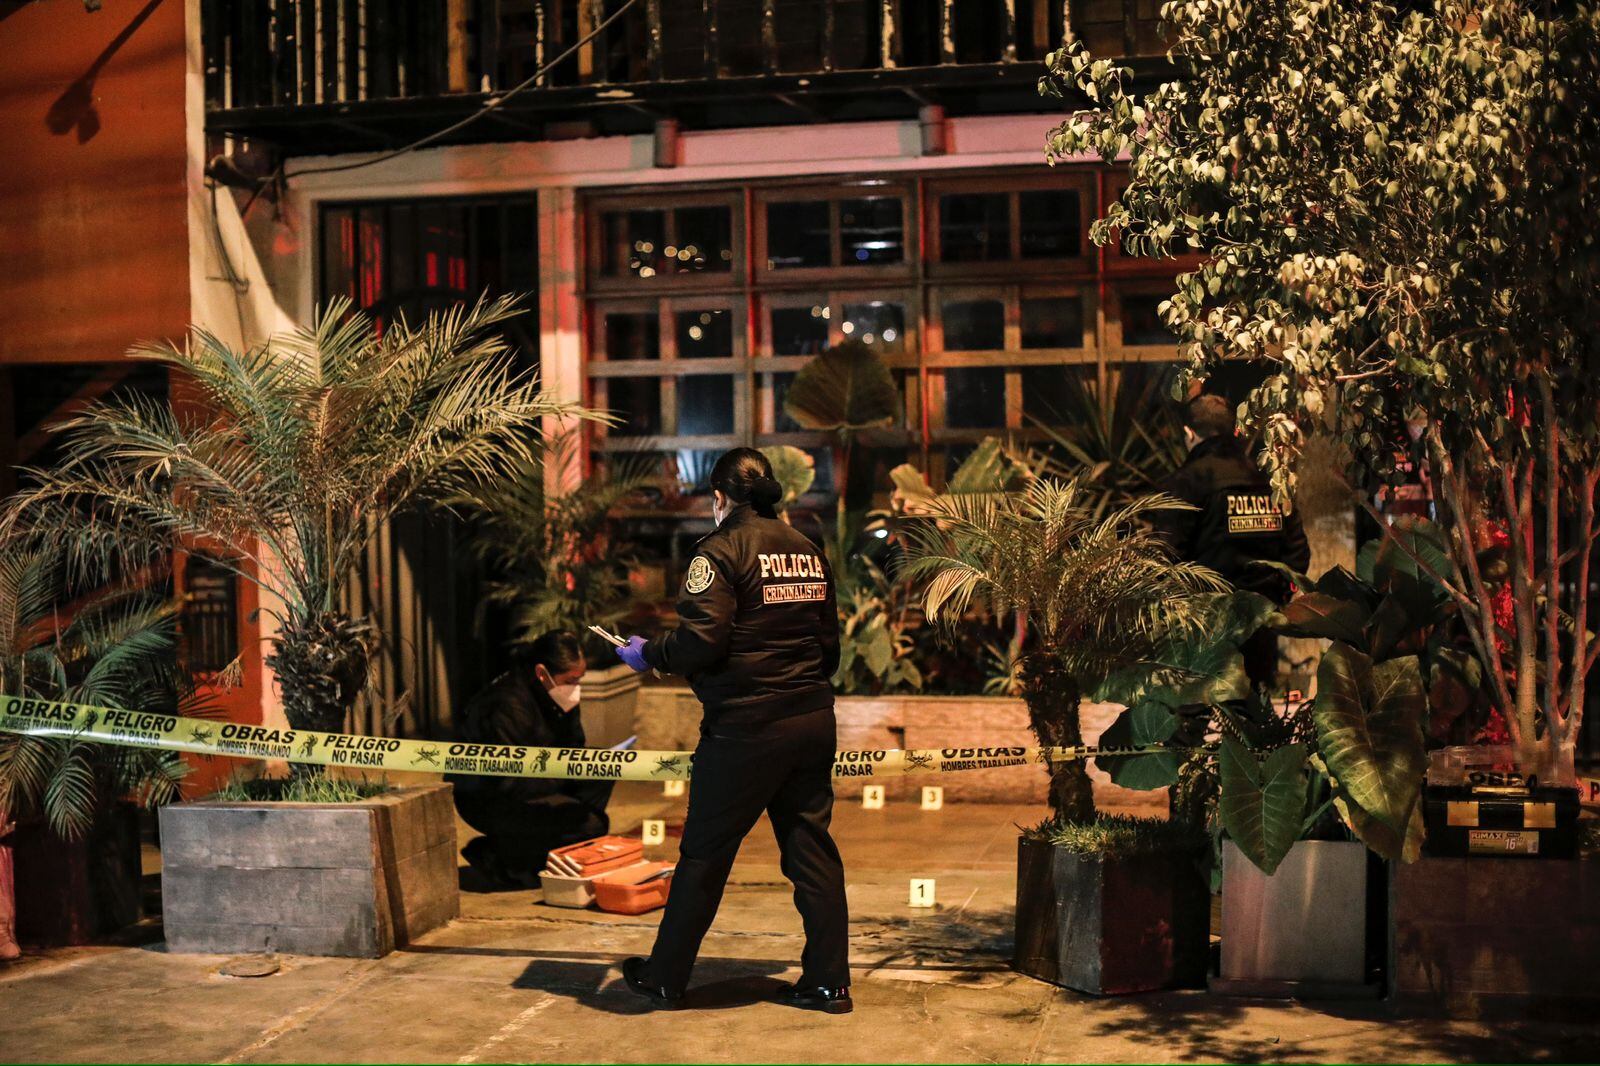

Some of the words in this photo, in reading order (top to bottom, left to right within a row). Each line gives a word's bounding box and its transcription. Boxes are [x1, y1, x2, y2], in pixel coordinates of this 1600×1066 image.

[758, 554, 824, 579] POLICIA
[6, 699, 77, 721] OBRAS
[103, 710, 177, 733] PELIGRO
[221, 724, 296, 744] OBRAS
[323, 735, 401, 752] PELIGRO
[332, 749, 347, 763] NO
[350, 751, 384, 766] PASAR
[449, 744, 528, 759] OBRAS
[557, 749, 638, 763] PELIGRO
[835, 750, 887, 762] IGRO
[941, 747, 1026, 759] OBRAS
[445, 756, 478, 772] HOMBRES
[479, 758, 524, 774] TRABAJANDO
[567, 762, 583, 776] NO
[586, 763, 622, 777] PASAR
[835, 763, 874, 777] PASAR
[941, 759, 977, 772] HOMBRES
[650, 823, 658, 837] 8
[1505, 838, 1517, 850] 16
[917, 884, 924, 898] 1
